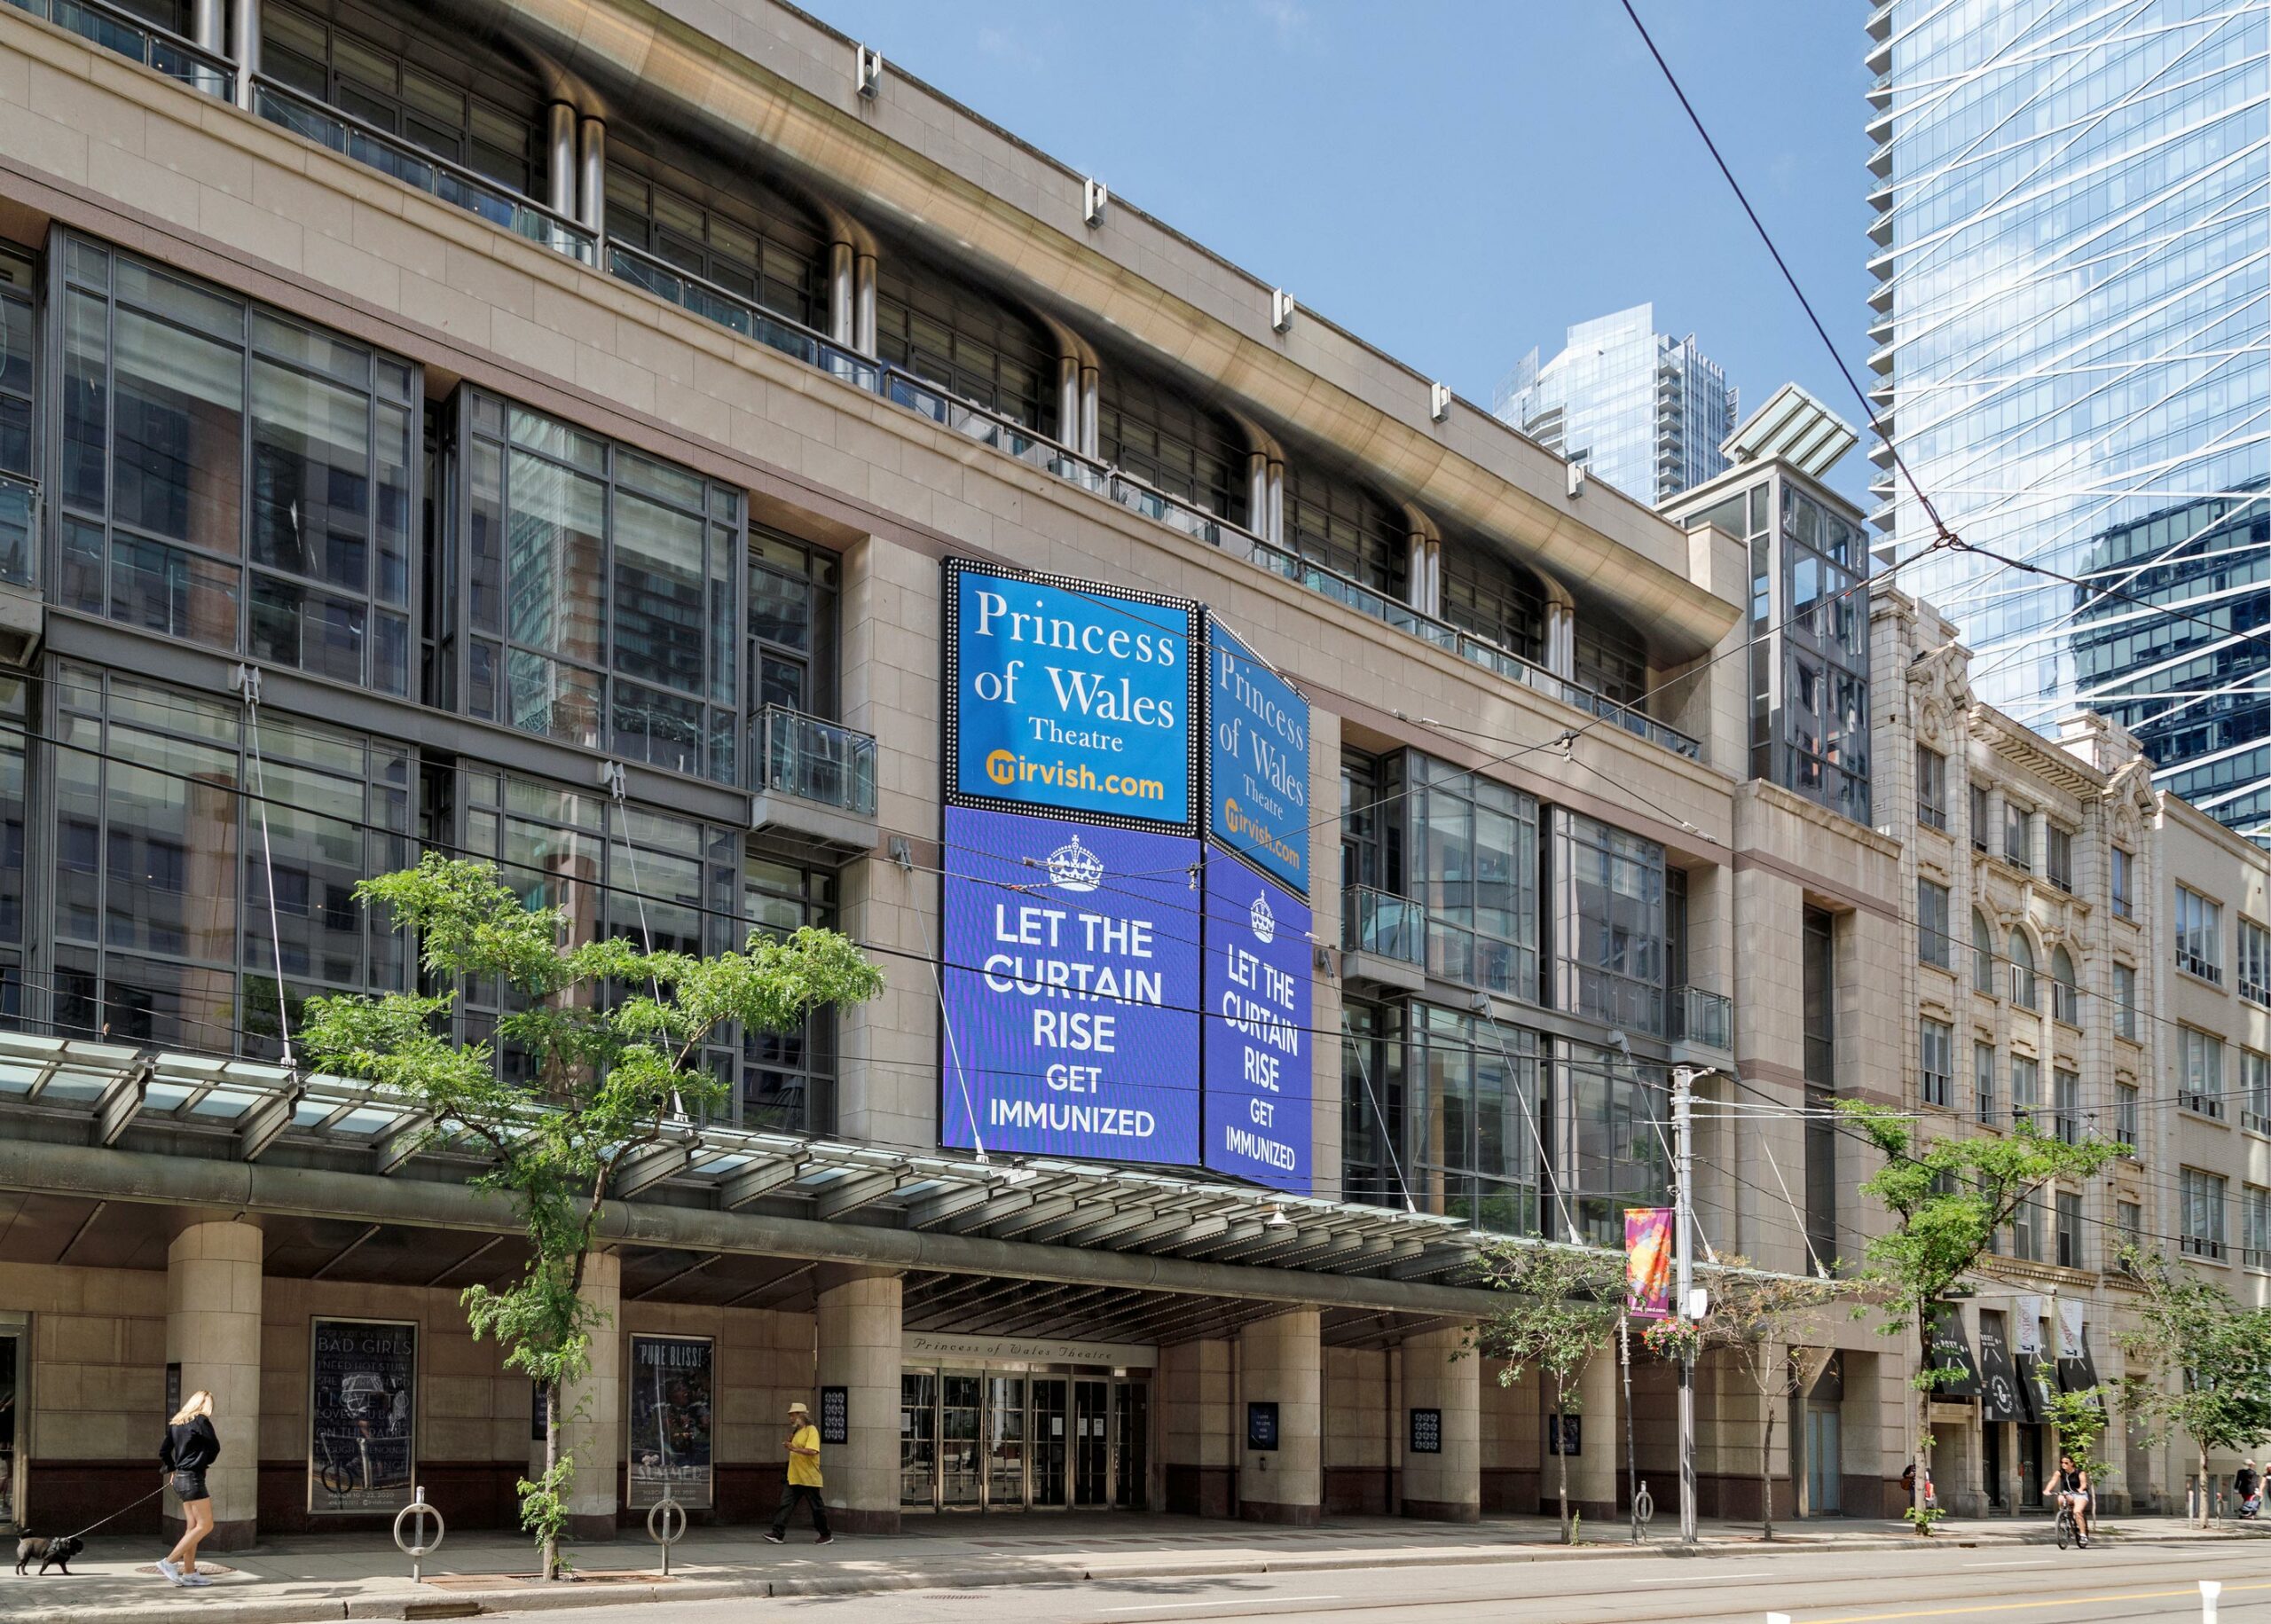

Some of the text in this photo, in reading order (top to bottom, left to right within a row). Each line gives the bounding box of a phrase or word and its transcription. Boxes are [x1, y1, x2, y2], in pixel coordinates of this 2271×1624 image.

[974, 590, 1175, 667] Princess
[975, 661, 1175, 728] of Wales
[1219, 644, 1304, 752] Princess
[1028, 717, 1124, 752] Theatre
[986, 749, 1165, 801] mirvish.com
[1219, 718, 1304, 808] of Wales
[1243, 773, 1285, 820] Theatre
[1225, 797, 1301, 870] mirvish.com
[995, 903, 1152, 958] LET THE
[984, 954, 1162, 1008] CURTAIN
[1228, 944, 1294, 1010] LET THE
[1033, 1009, 1116, 1053] RISE
[1222, 991, 1298, 1056] CURTAIN
[1046, 1064, 1102, 1094] GET
[1245, 1046, 1279, 1093] RISE
[991, 1098, 1155, 1137] IMMUNIZED
[1250, 1097, 1274, 1128] GET
[1226, 1126, 1295, 1172] IMMUNIZED
[318, 1337, 412, 1355] BAD GIRLS
[323, 1361, 352, 1370] NEED
[354, 1361, 376, 1371] HOT
[913, 1338, 1112, 1360] Princess of Wales Theatre
[318, 1376, 337, 1385] SHE
[329, 1392, 377, 1408] LOVE
[385, 1393, 410, 1408] TO
[316, 1426, 335, 1438] ON
[317, 1408, 348, 1419] LOVE
